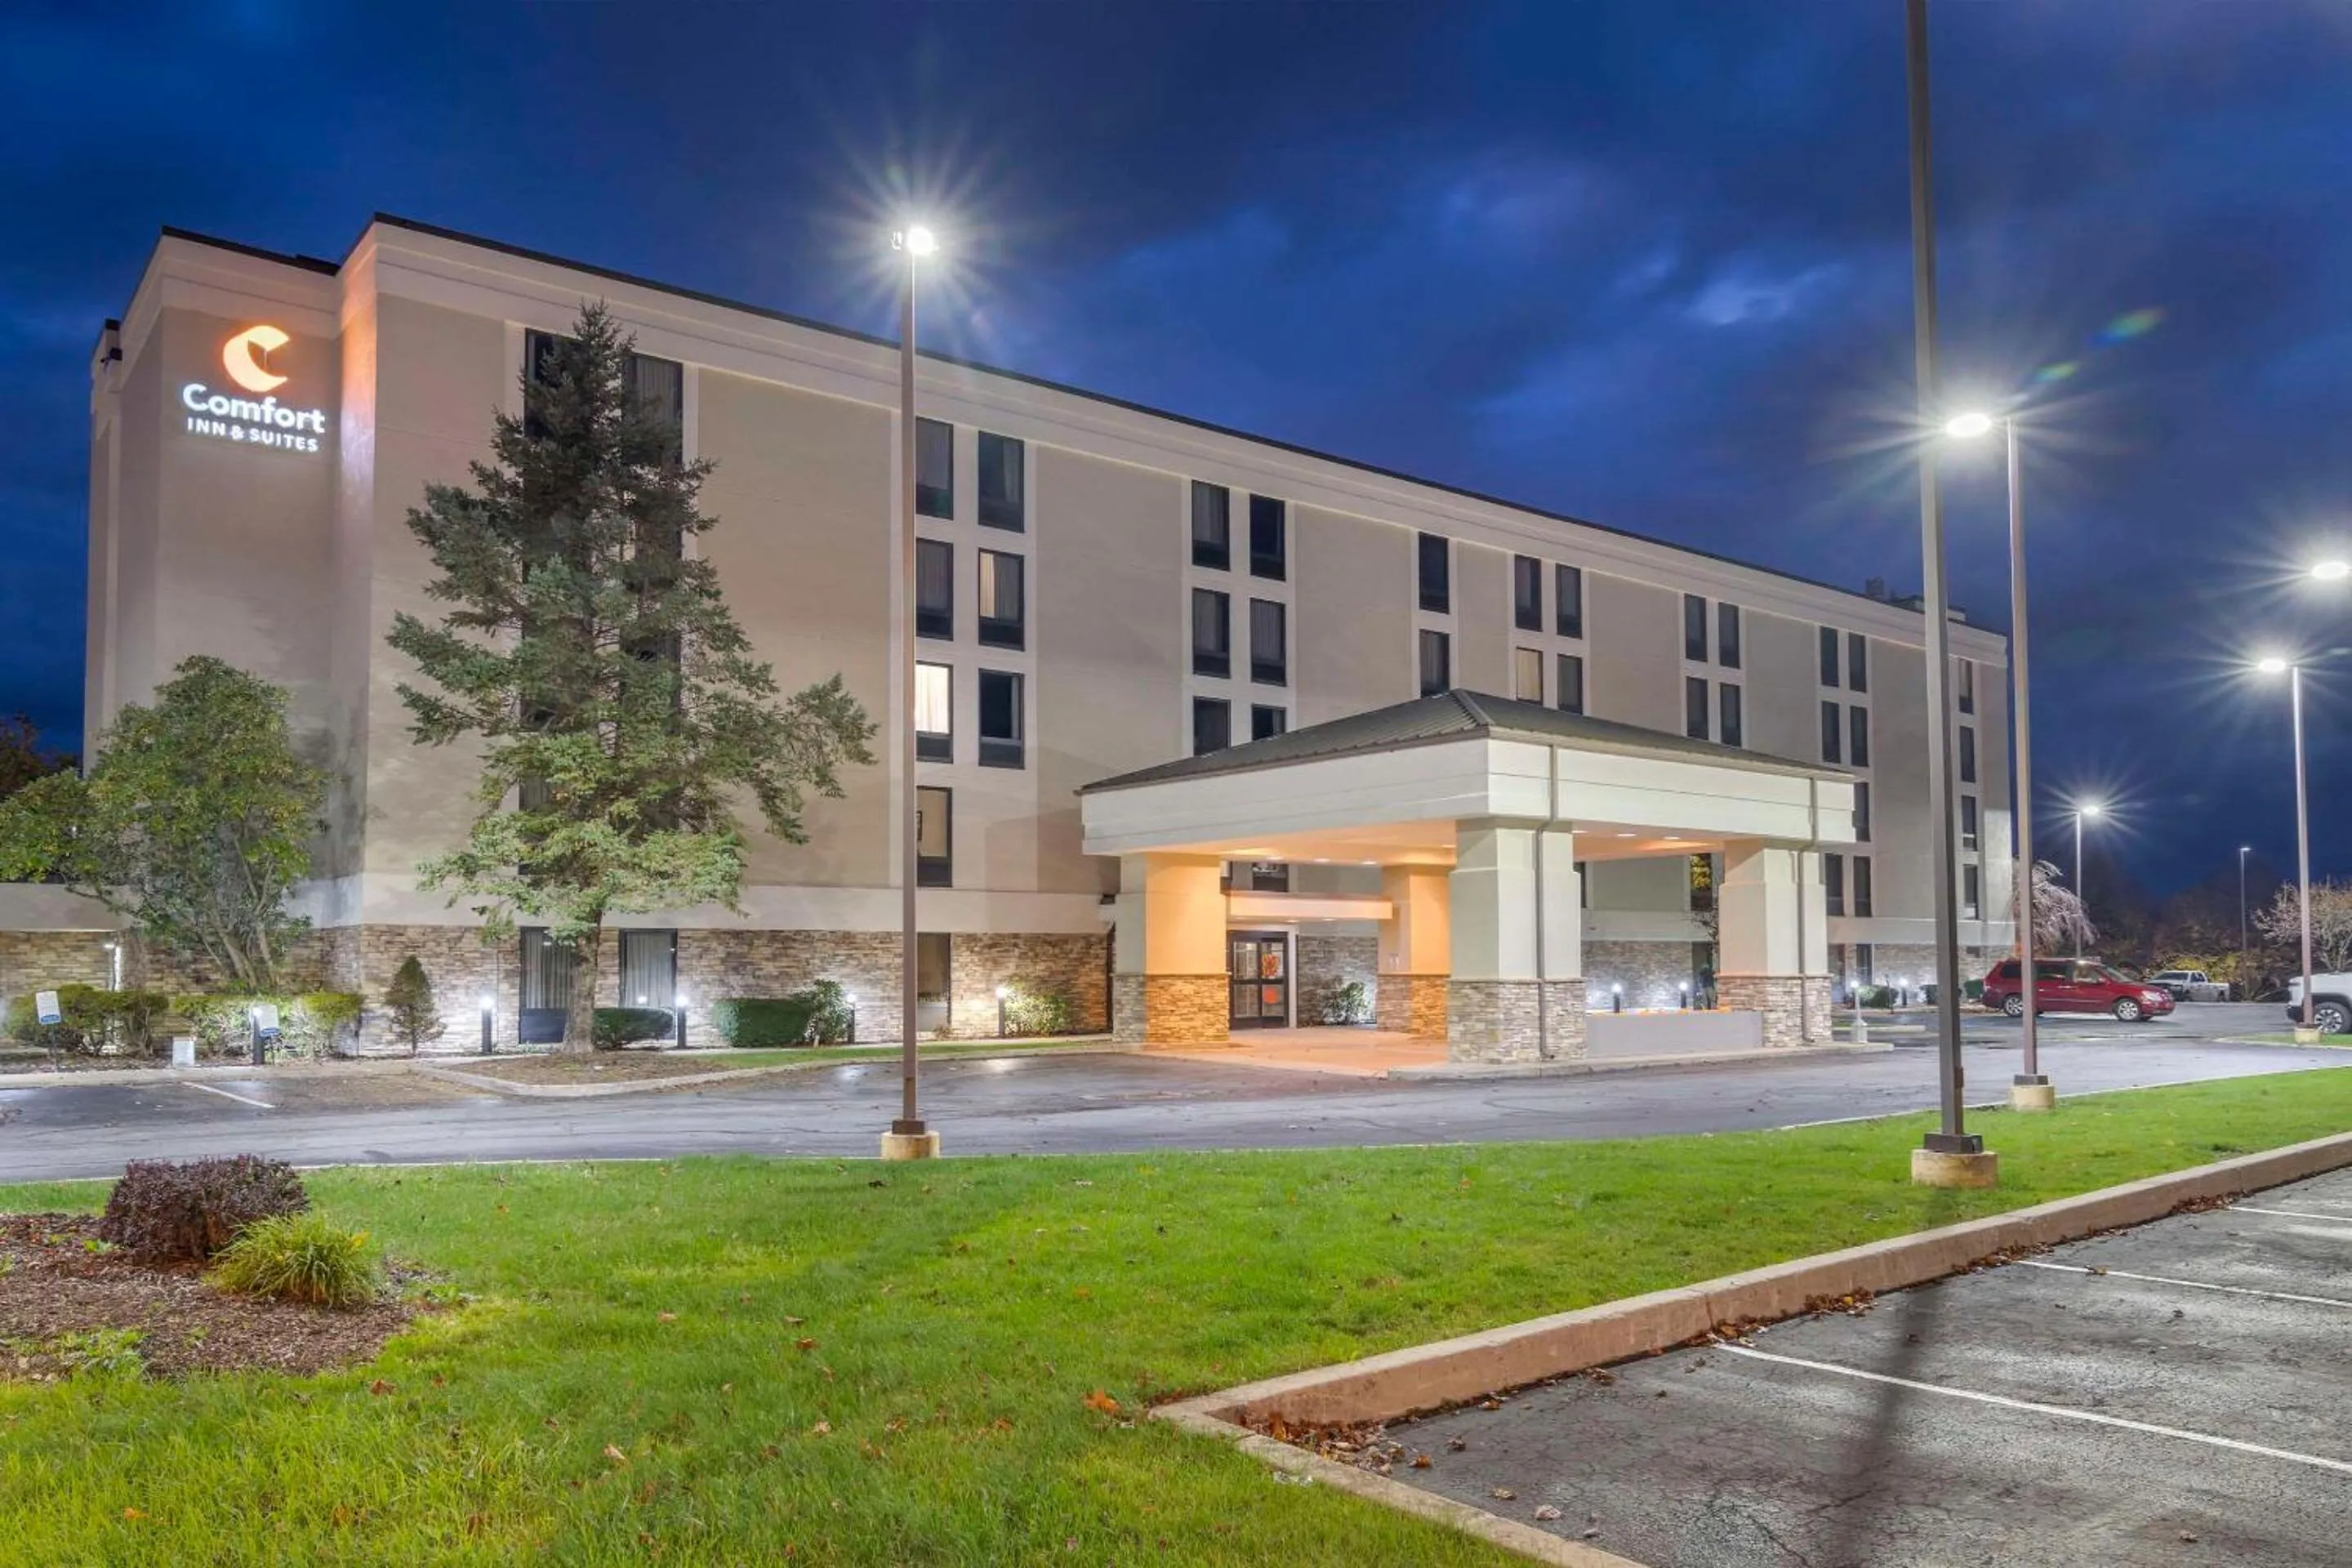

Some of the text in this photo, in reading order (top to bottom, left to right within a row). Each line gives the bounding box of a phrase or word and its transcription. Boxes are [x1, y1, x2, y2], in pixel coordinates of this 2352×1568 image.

[183, 383, 325, 434] Comfort
[187, 416, 318, 452] INN & SUITES
